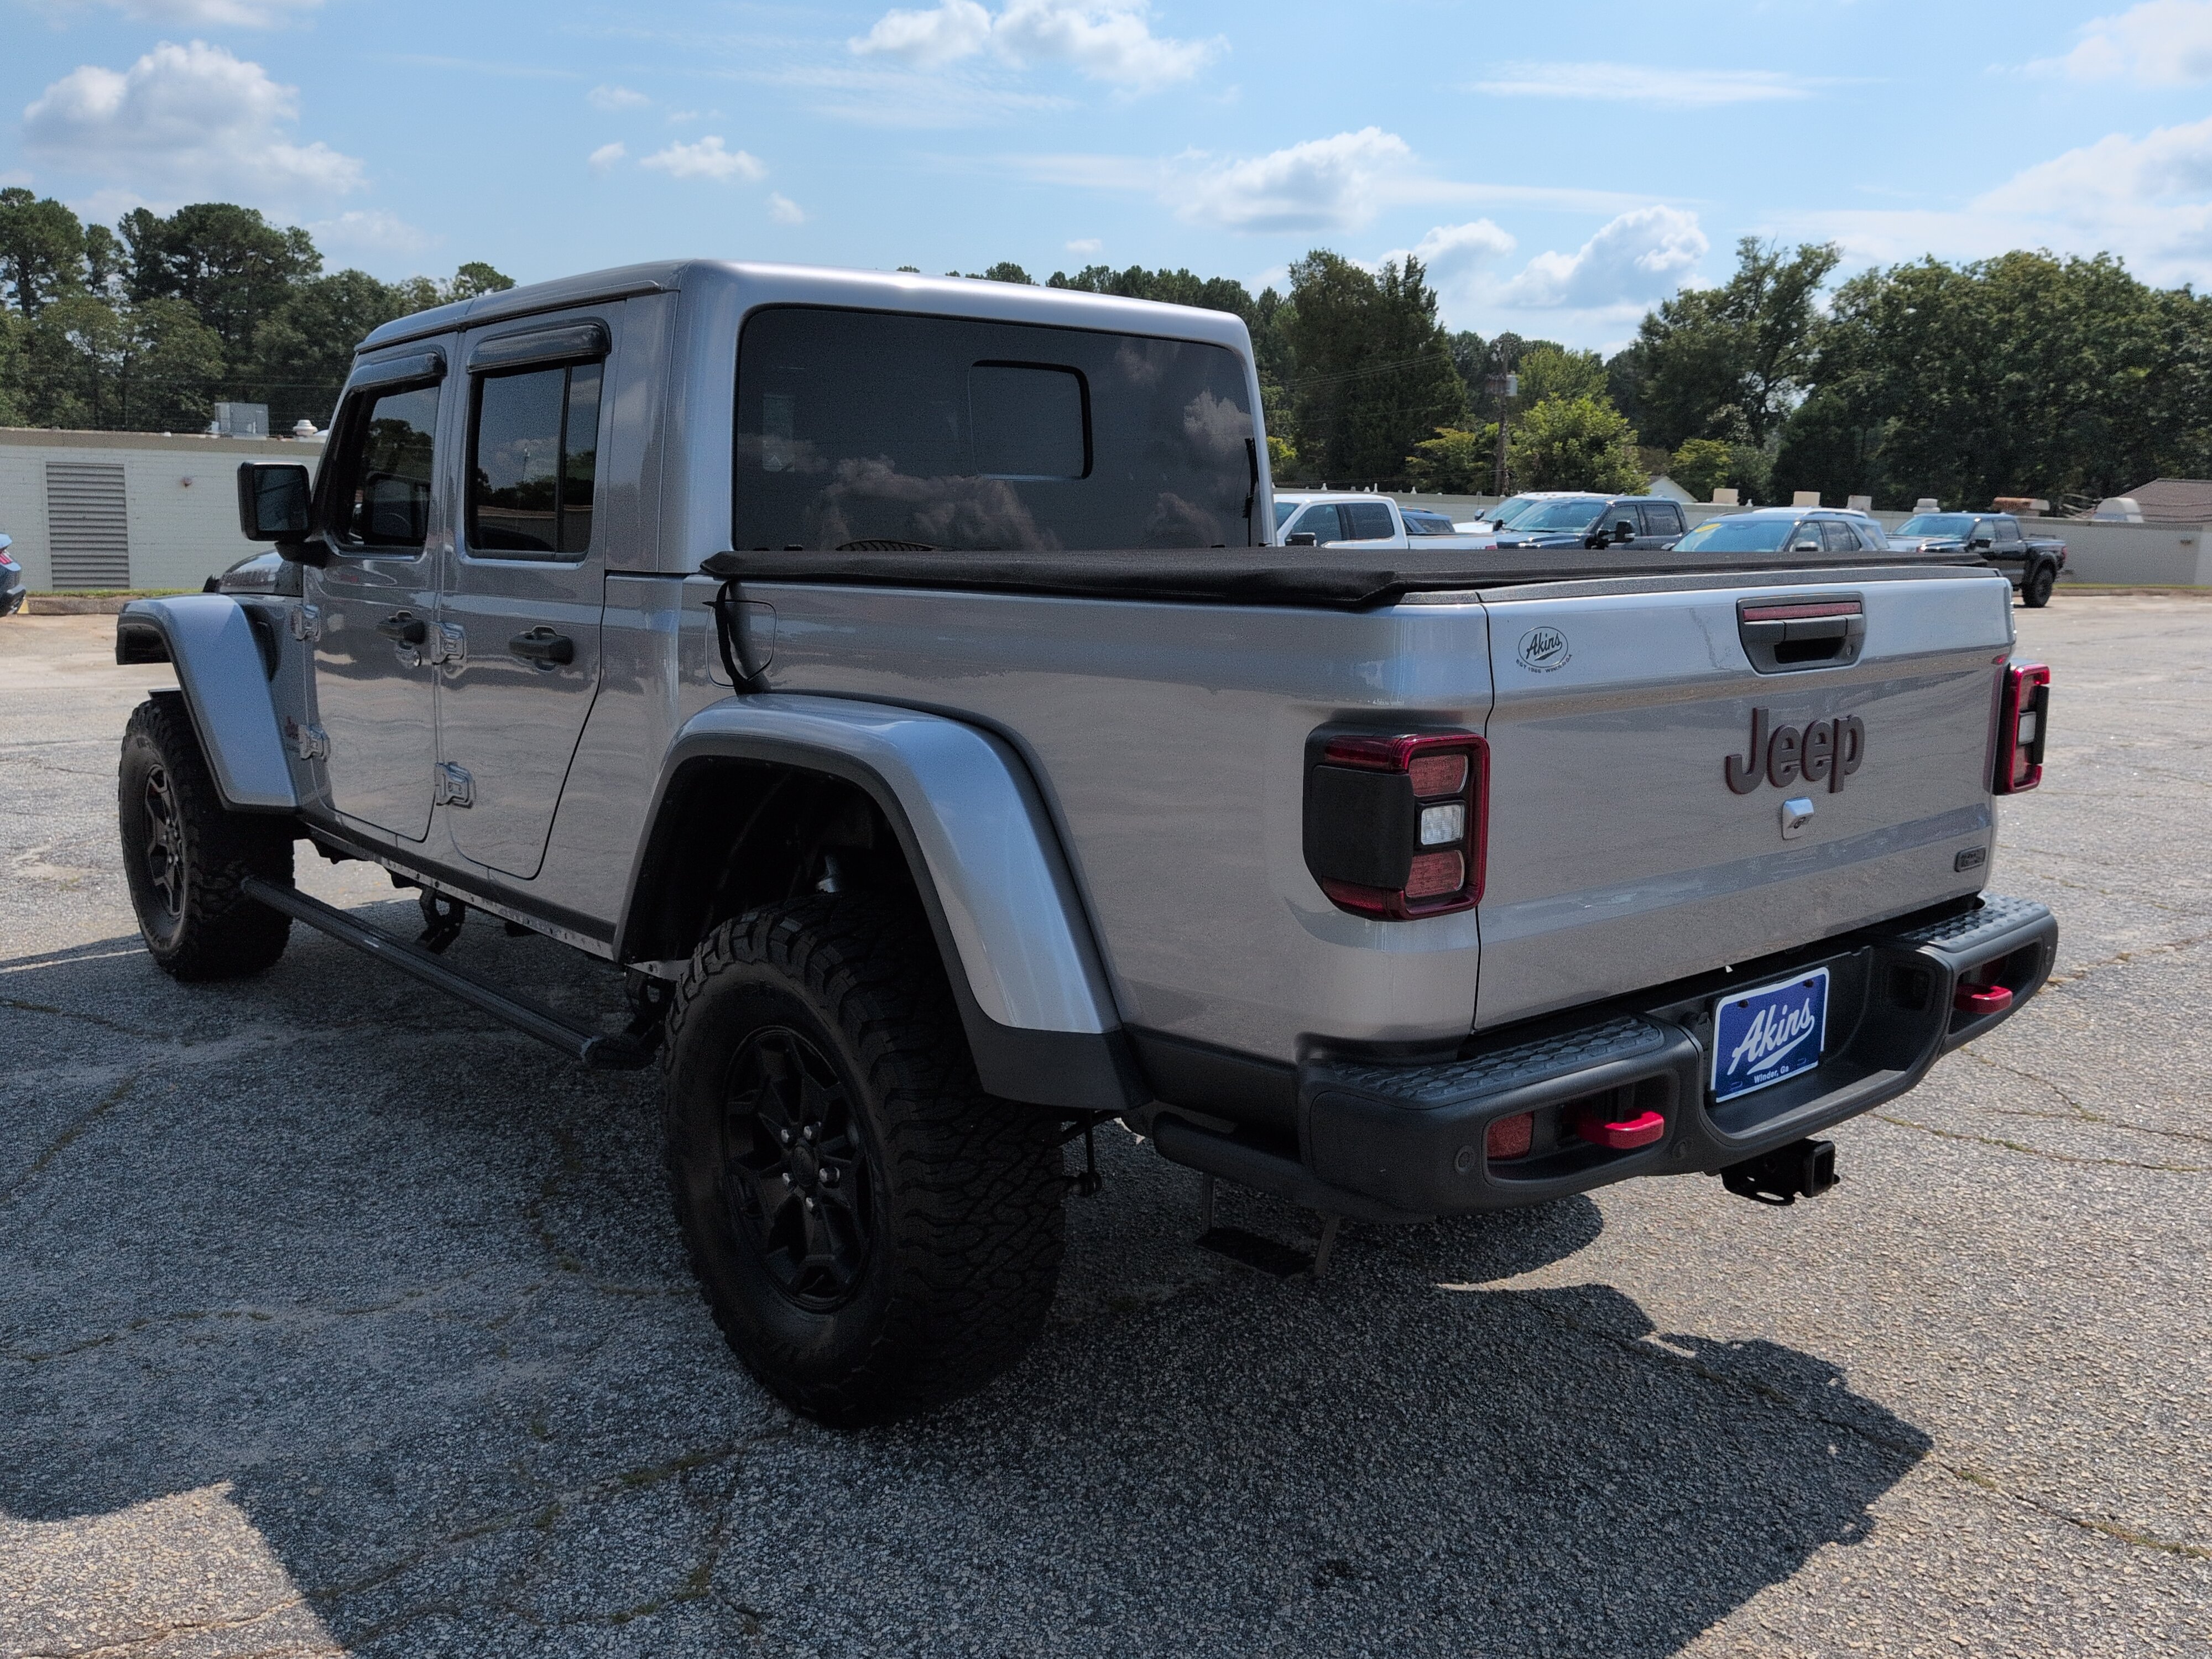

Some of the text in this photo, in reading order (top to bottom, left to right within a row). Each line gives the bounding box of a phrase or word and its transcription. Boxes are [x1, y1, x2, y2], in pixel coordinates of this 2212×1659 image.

[1526, 632, 1562, 659] Akins
[1725, 706, 1865, 794] Jeep
[1727, 998, 1815, 1076] Akins
[1754, 1066, 1790, 1084] Winder, Ga
